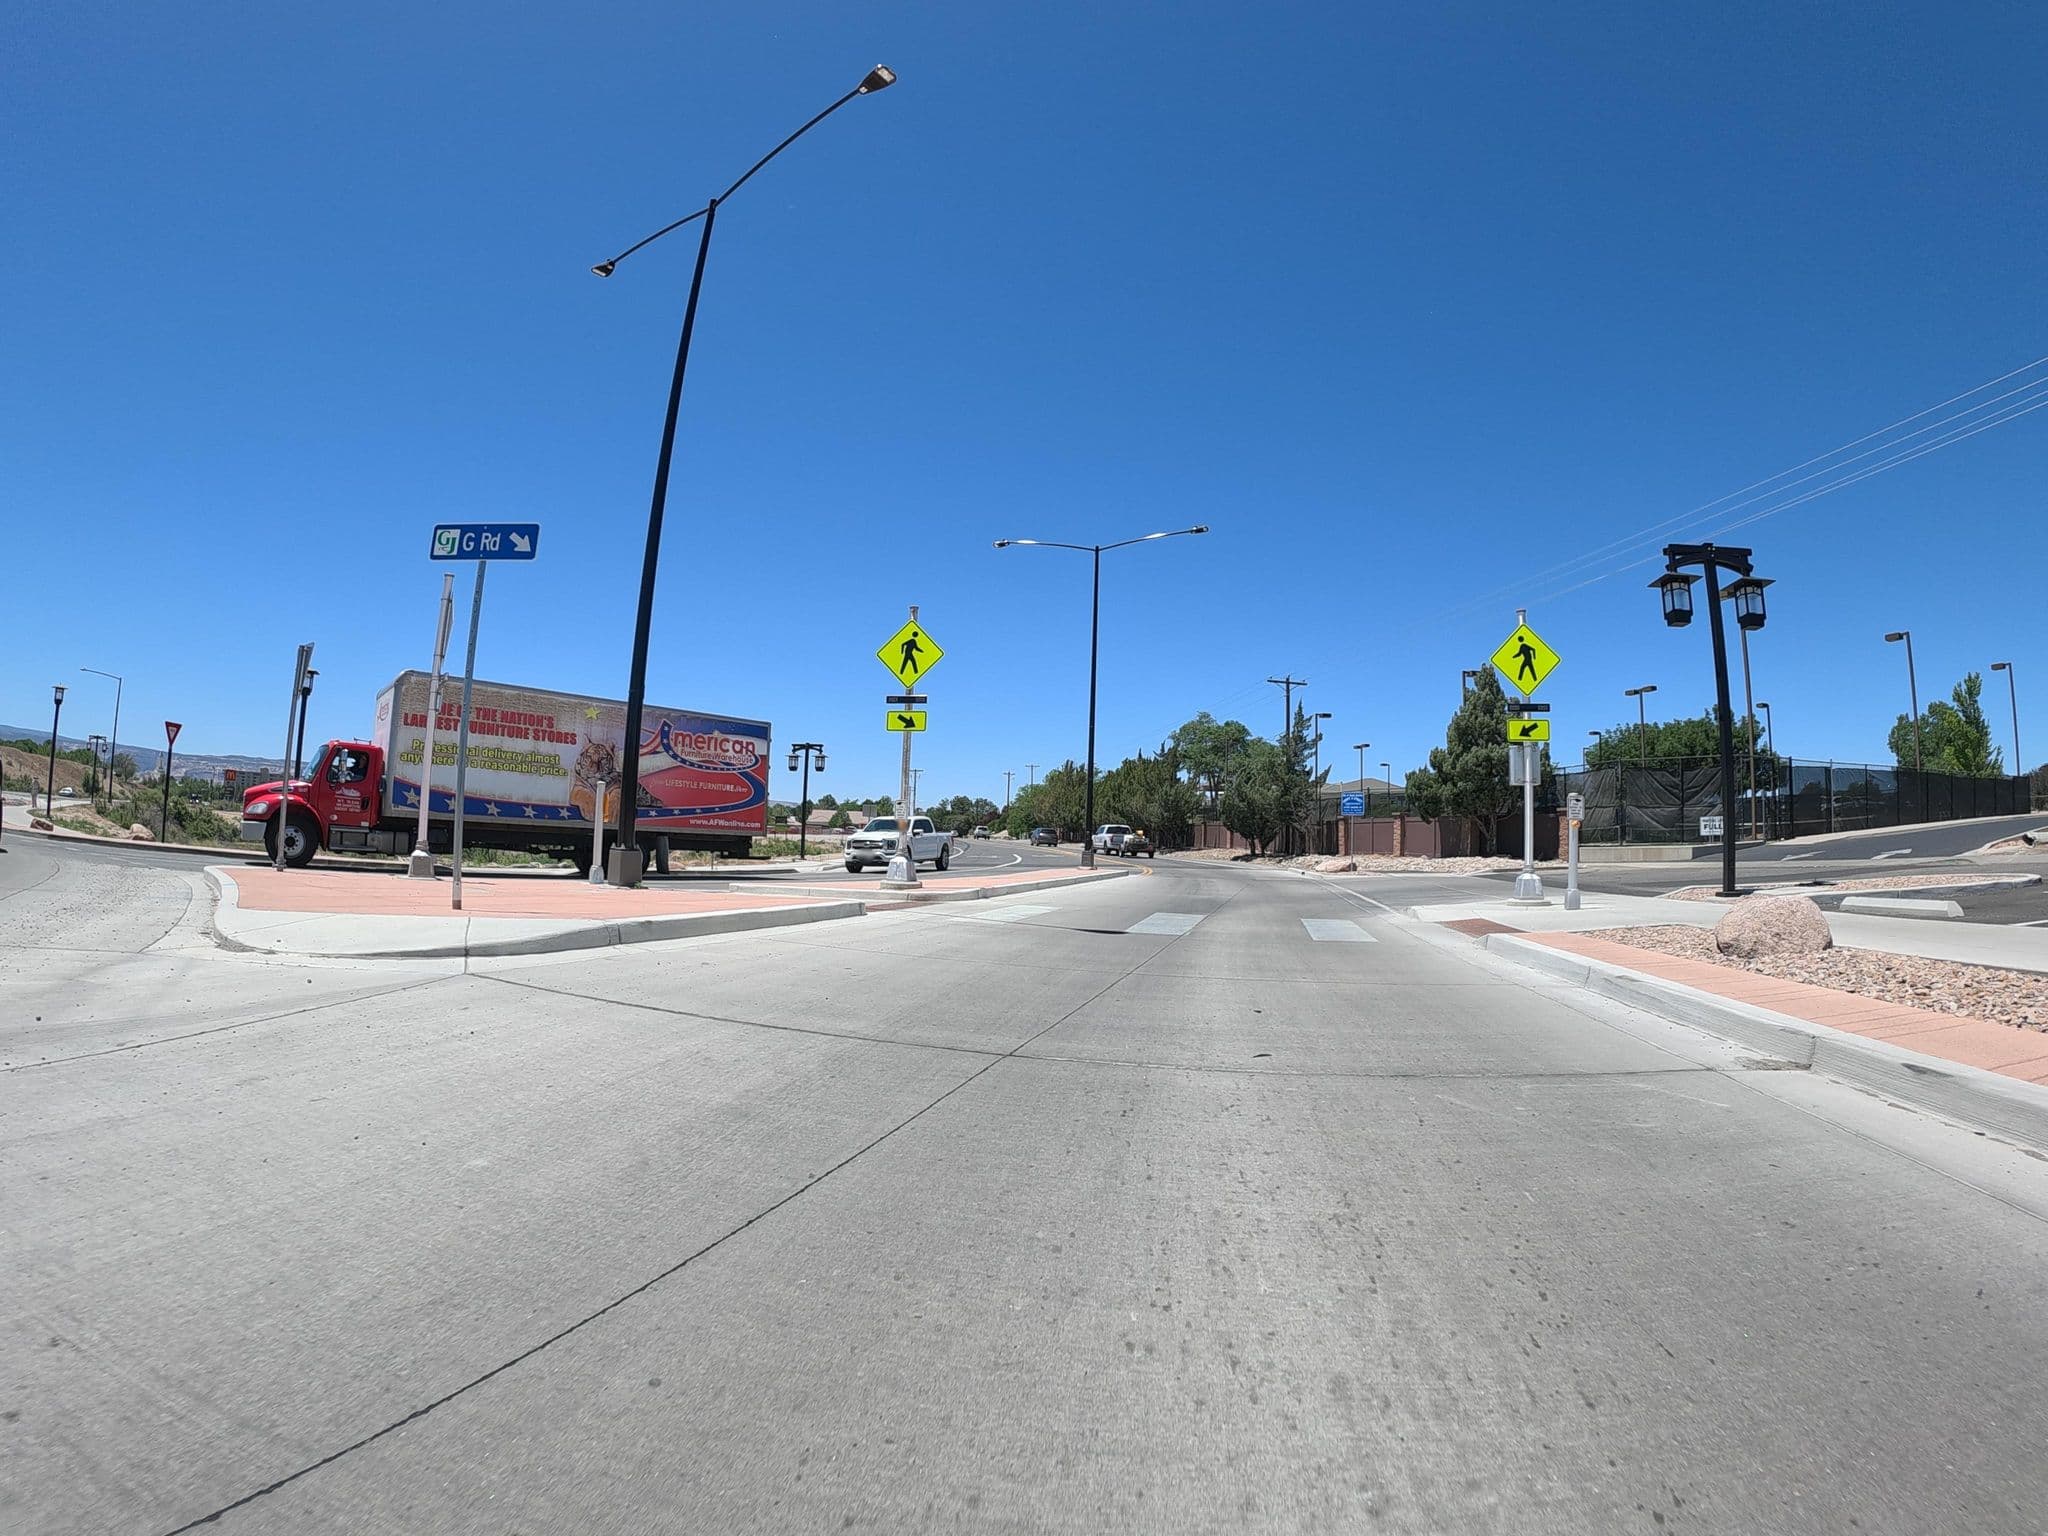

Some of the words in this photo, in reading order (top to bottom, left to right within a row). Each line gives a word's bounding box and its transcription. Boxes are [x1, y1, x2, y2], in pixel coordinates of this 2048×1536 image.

[463, 532, 476, 551] G
[480, 532, 501, 551] Rd
[475, 706, 497, 722] THE
[500, 710, 554, 729] NATION'S
[403, 712, 460, 732] LAREST
[468, 720, 530, 740] URNITURE
[532, 728, 577, 746] STORES
[481, 747, 523, 763] delivery
[526, 751, 560, 766] almost
[480, 760, 537, 774] reasonable
[540, 763, 568, 777] price.
[1703, 823, 1724, 831] FULL
